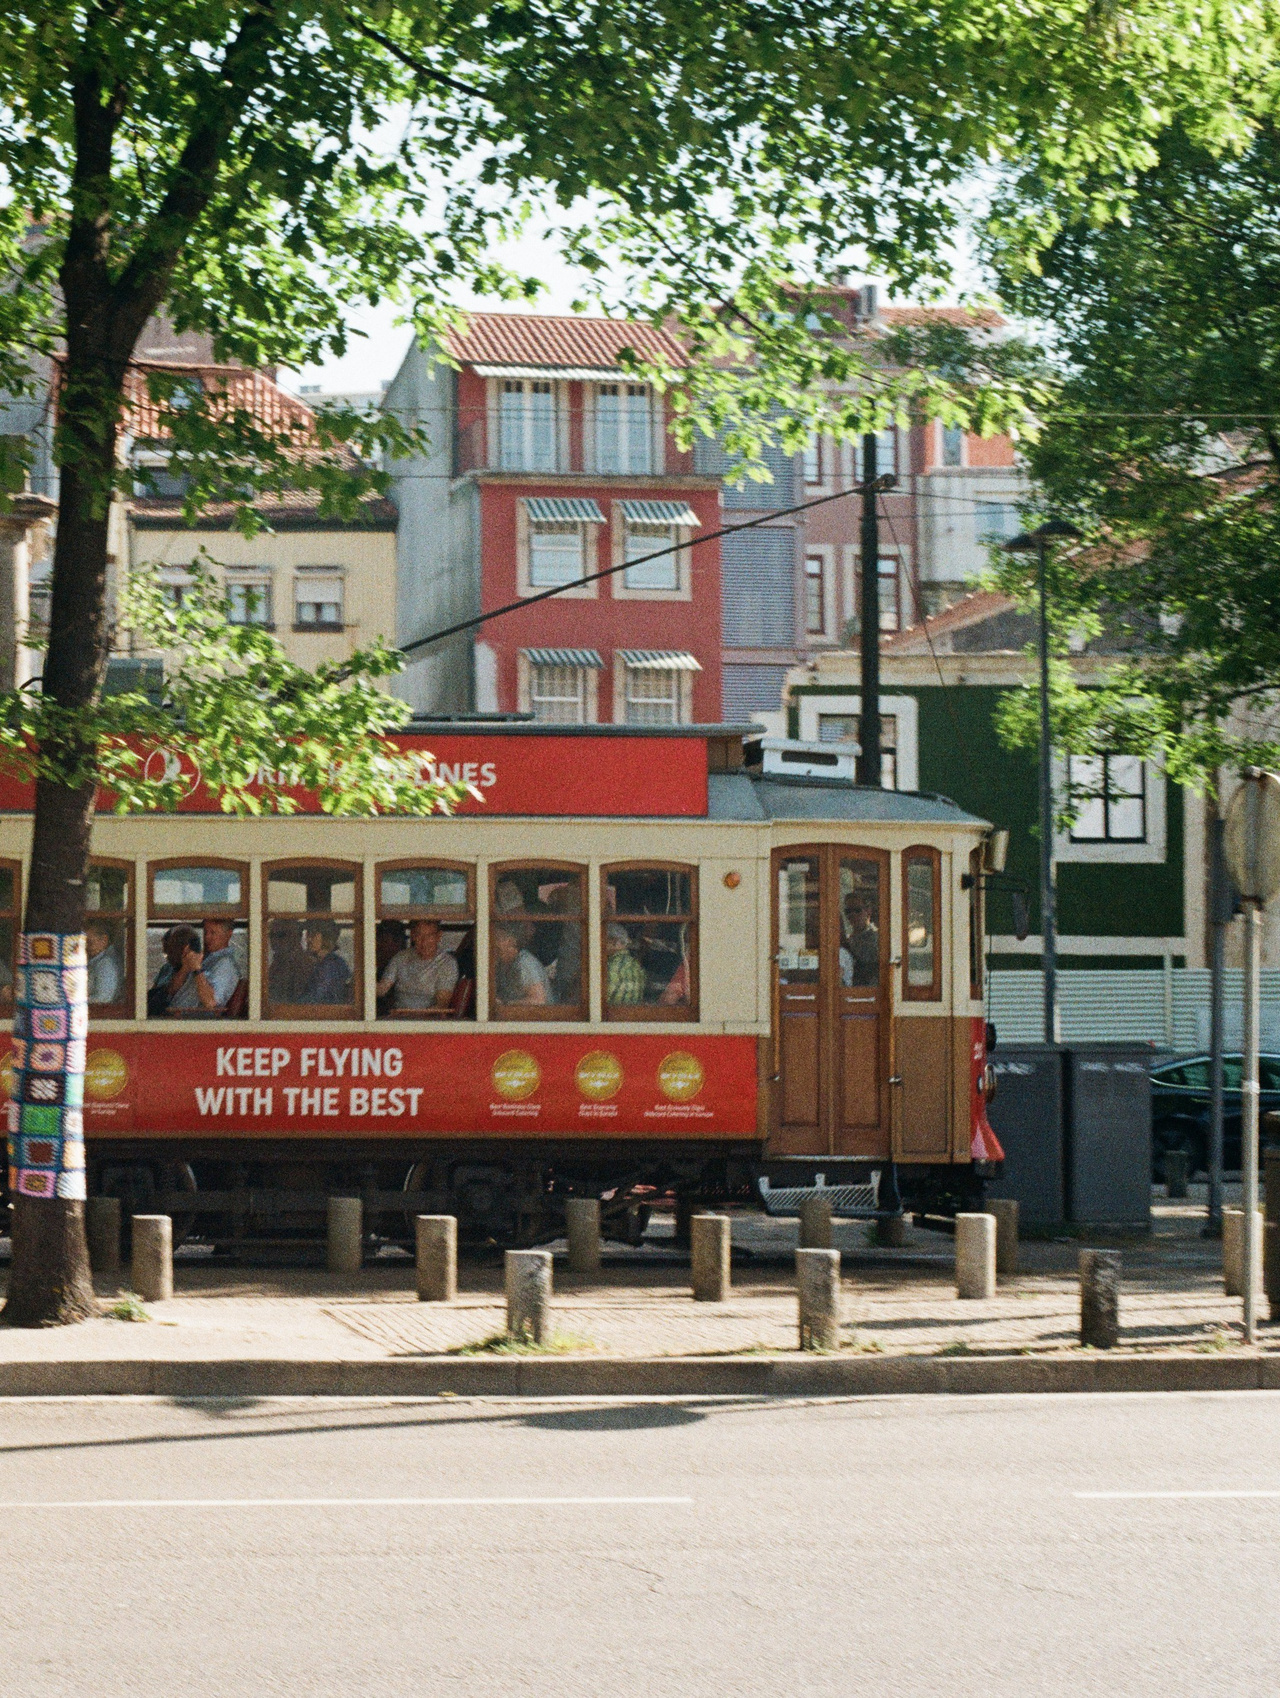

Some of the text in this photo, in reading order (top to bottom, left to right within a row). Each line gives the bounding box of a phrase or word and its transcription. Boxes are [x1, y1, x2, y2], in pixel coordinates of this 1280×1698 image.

[360, 762, 498, 786] LINES
[216, 1047, 404, 1077] KEEP FLYING
[195, 1086, 424, 1116] WITH THE BEST
